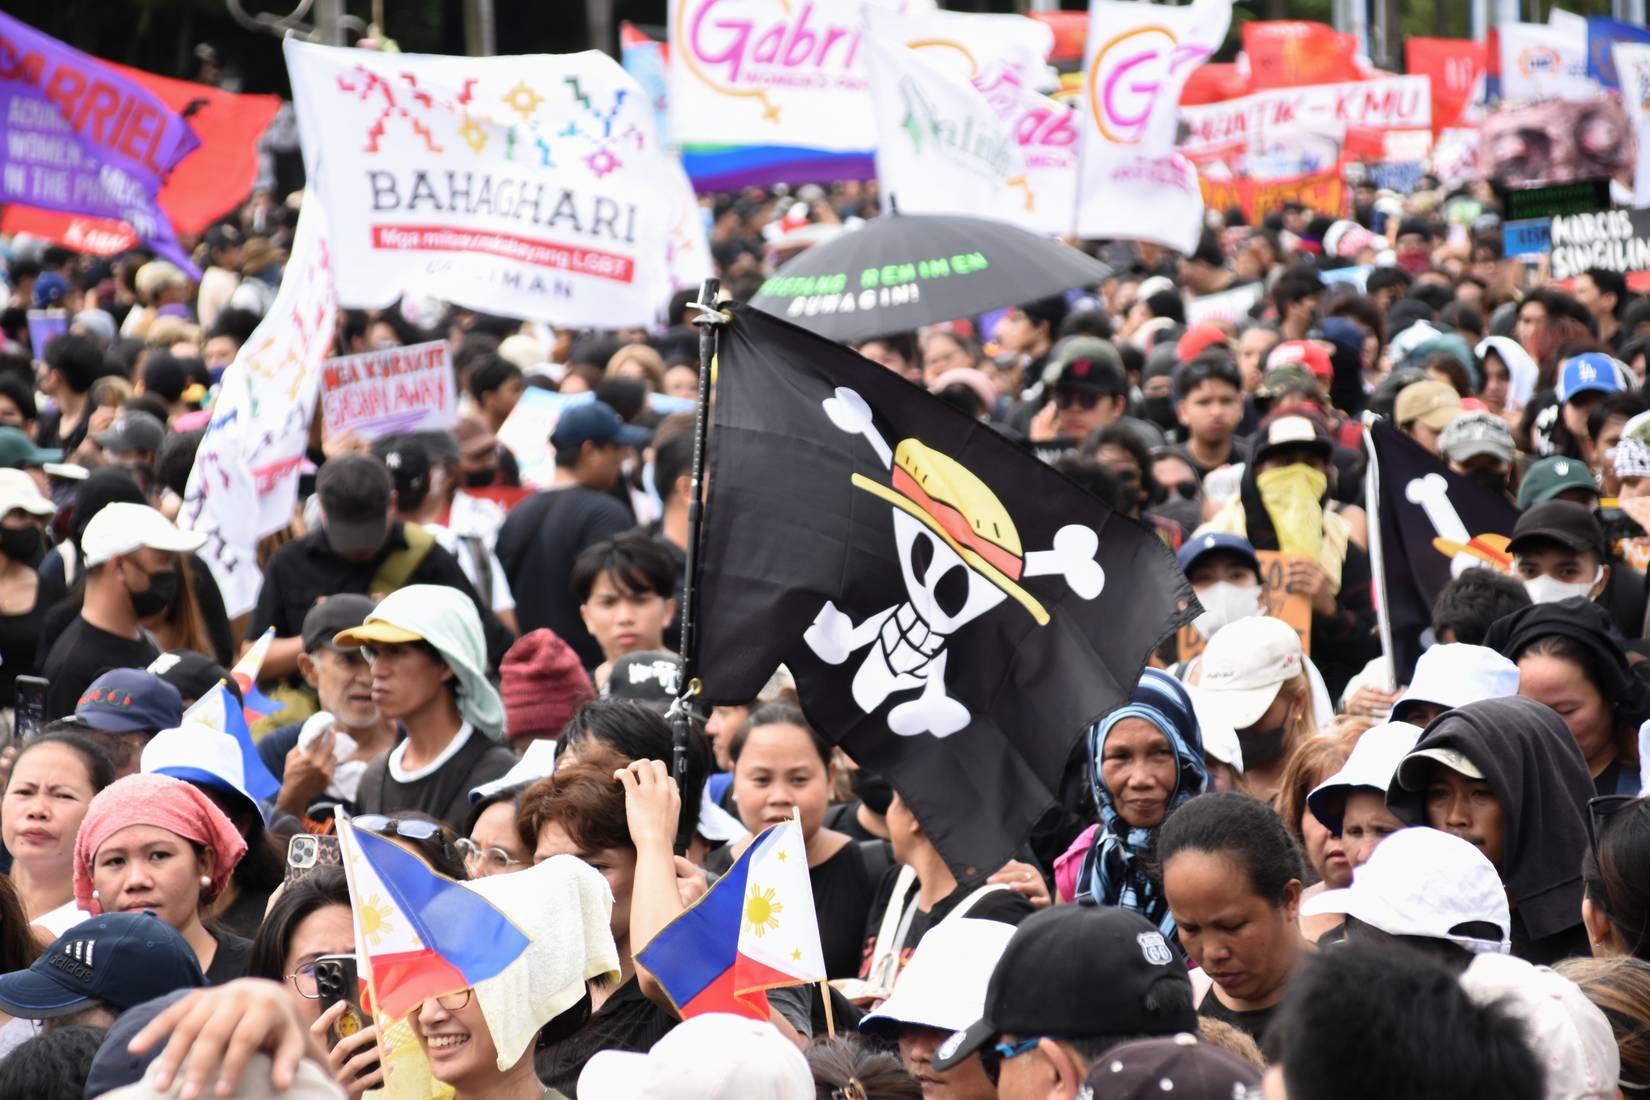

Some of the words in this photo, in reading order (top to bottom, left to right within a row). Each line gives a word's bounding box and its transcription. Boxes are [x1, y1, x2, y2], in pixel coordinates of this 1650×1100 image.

[368, 170, 638, 242] BAHAGHARI
[572, 251, 627, 278] LGBT
[1147, 944, 1170, 961] 66
[48, 955, 93, 982] adidas
